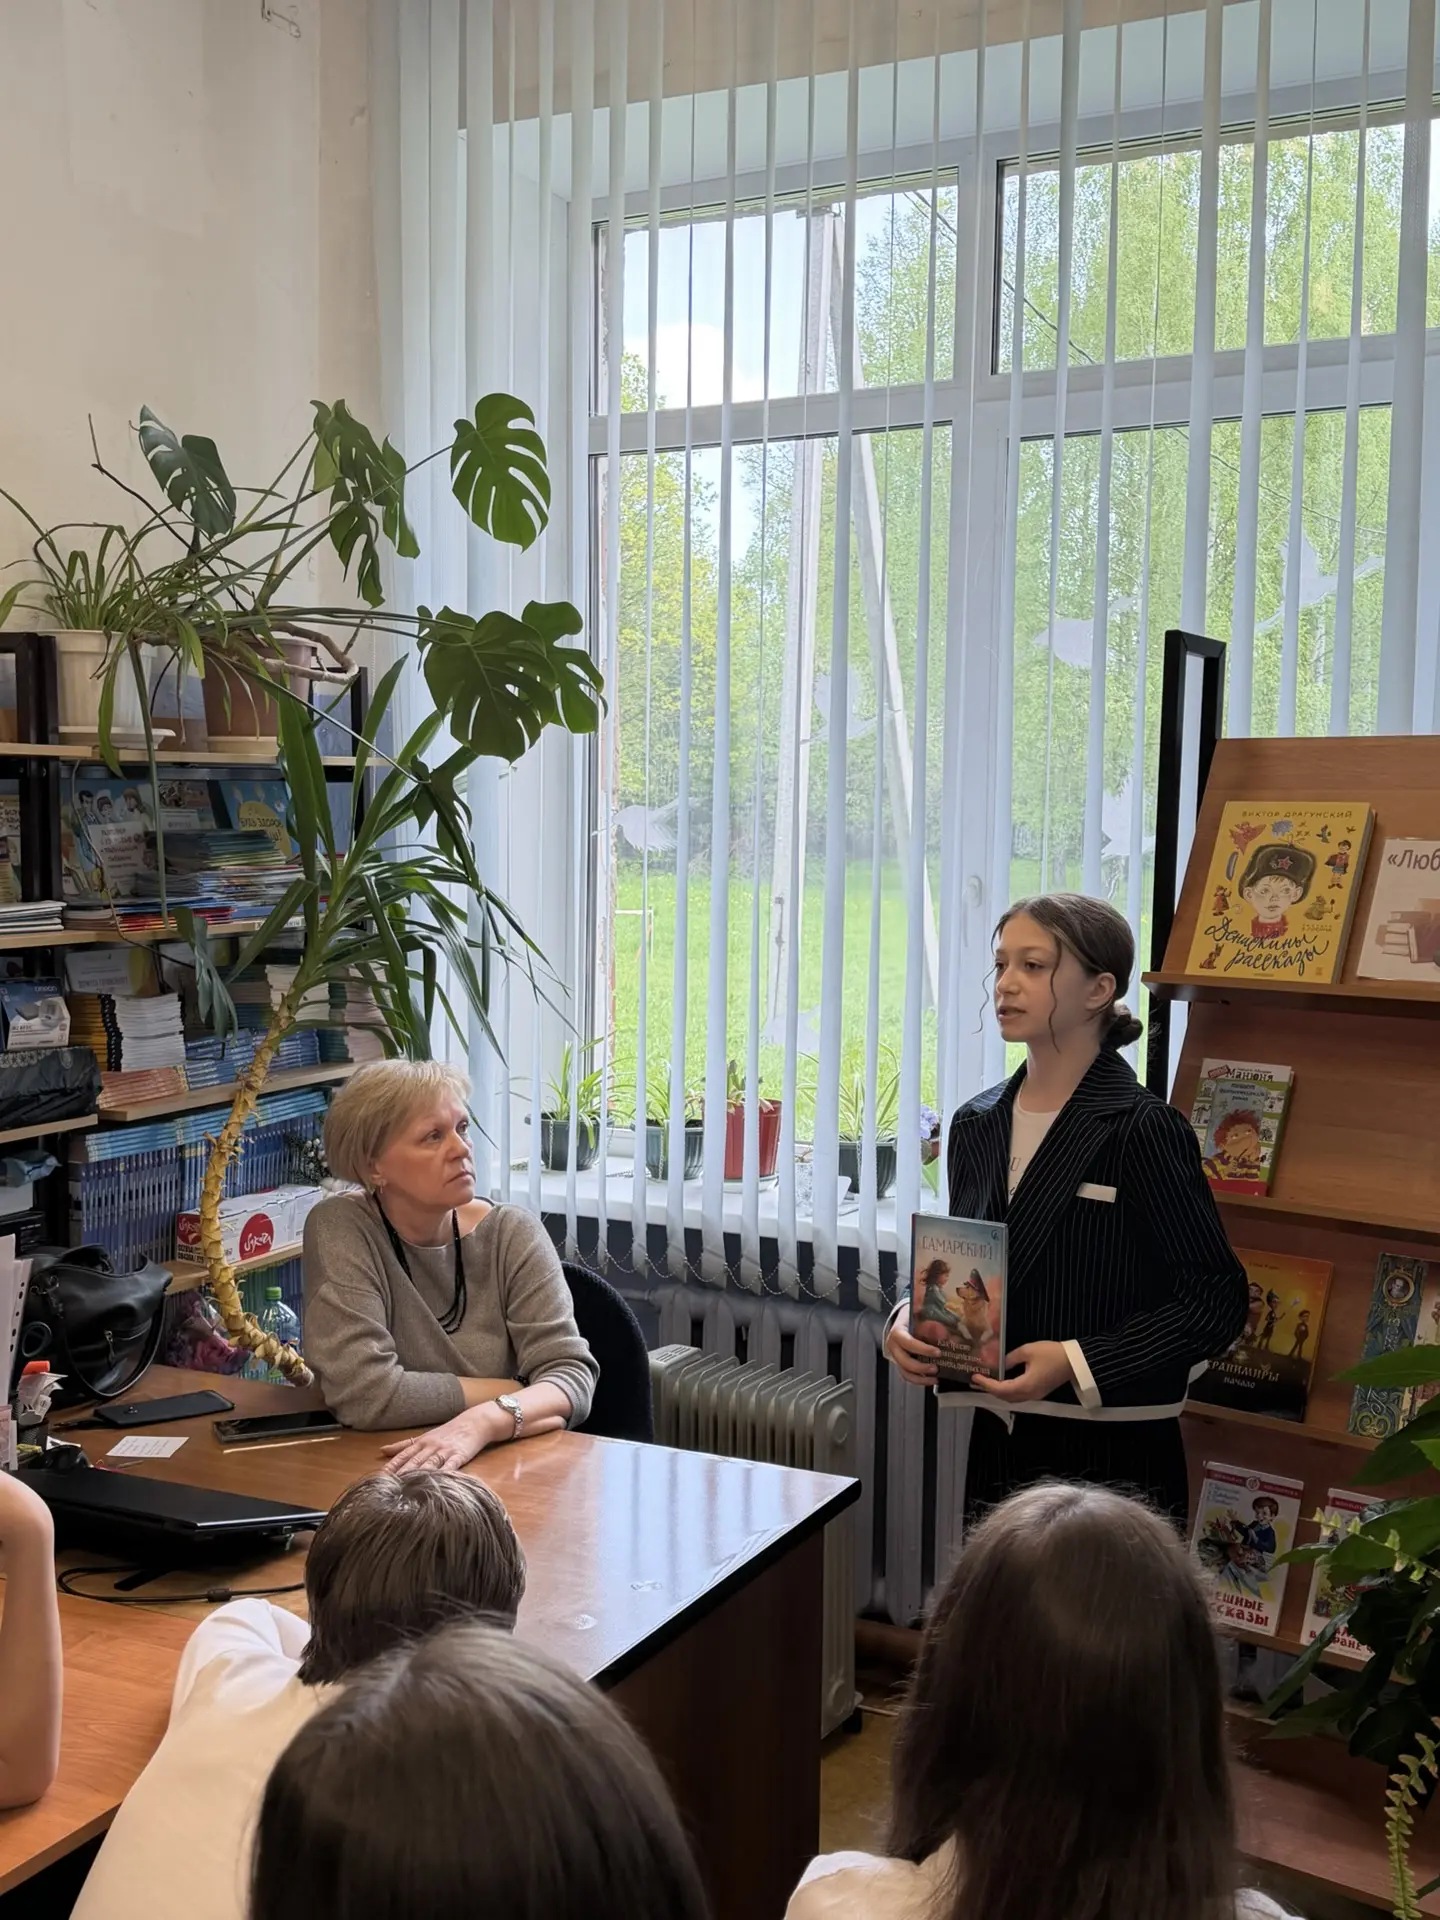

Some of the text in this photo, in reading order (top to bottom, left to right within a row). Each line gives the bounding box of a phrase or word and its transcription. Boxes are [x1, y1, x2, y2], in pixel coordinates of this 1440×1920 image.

[1241, 810, 1352, 819] ВИКТОР ДРАГУНСКИЙ
[1204, 916, 1317, 952] Денискины
[1224, 940, 1329, 976] рассказы
[1225, 1068, 1274, 1082] Манюня
[922, 1235, 993, 1260] САМАРСКИЙ
